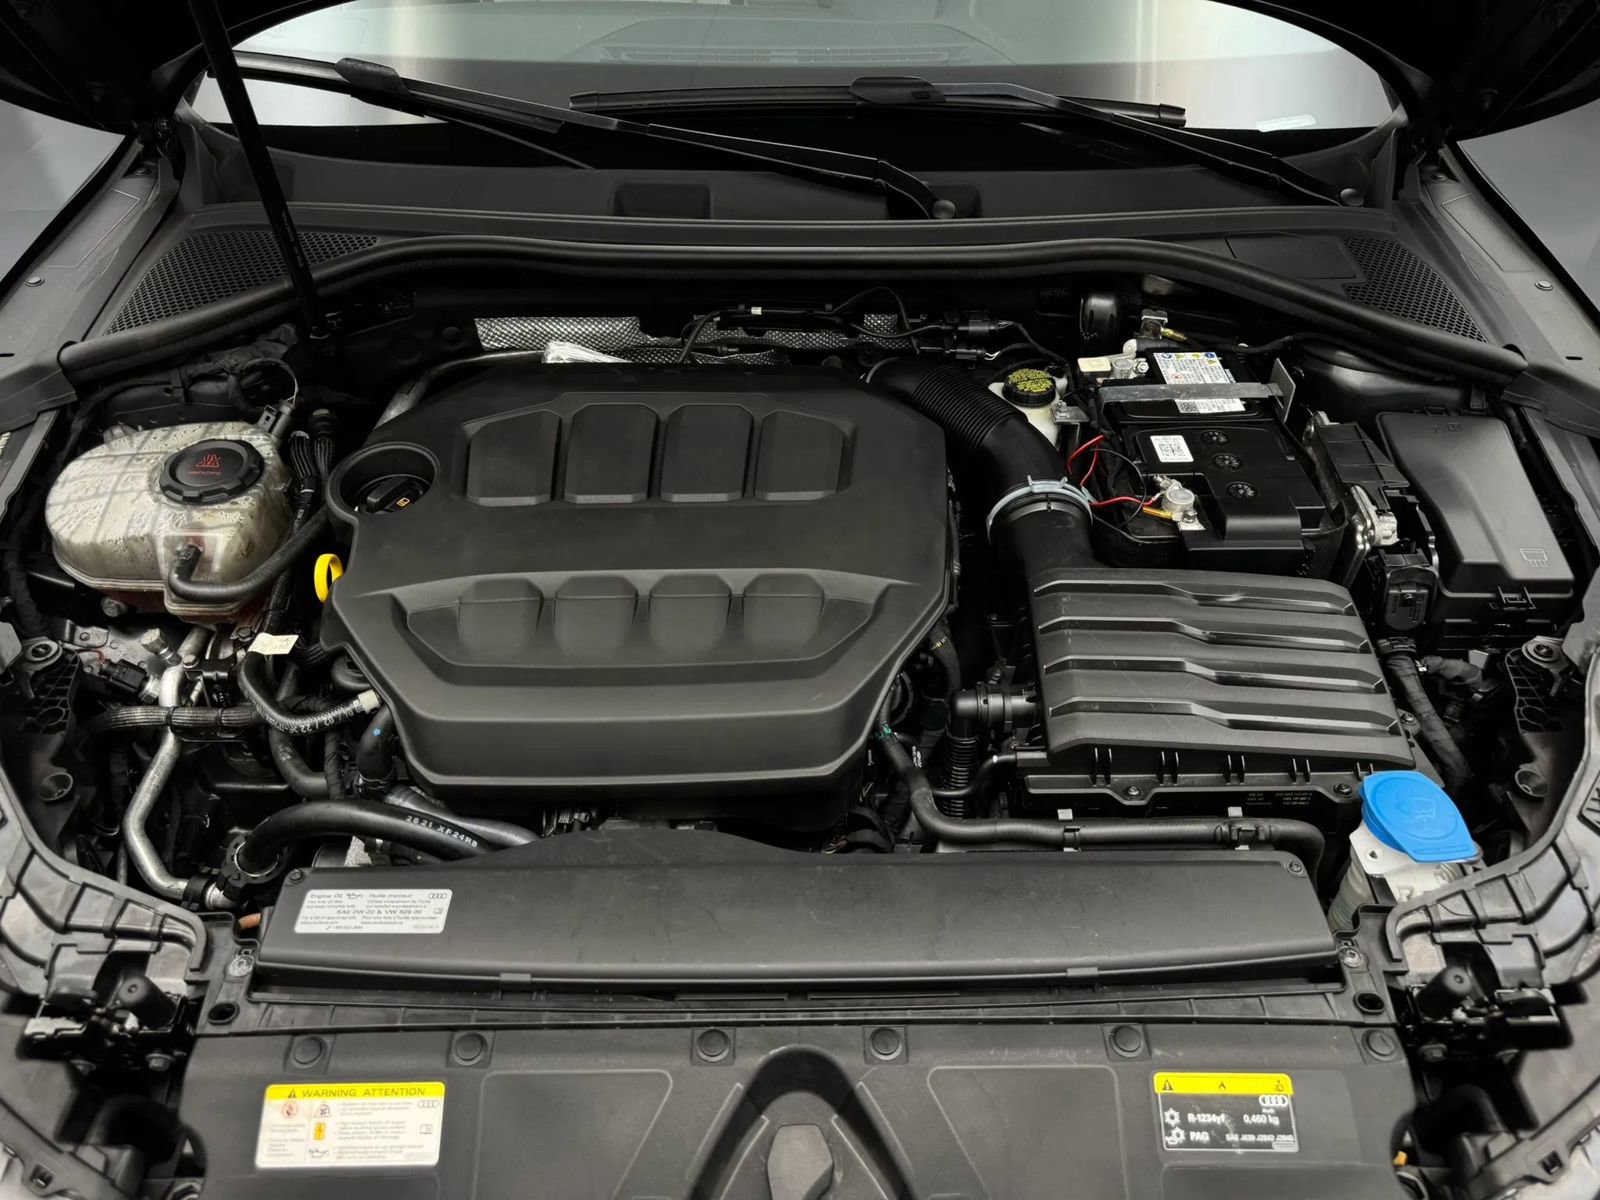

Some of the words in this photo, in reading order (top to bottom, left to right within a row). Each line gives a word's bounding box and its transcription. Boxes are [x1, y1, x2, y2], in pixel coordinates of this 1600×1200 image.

[302, 1088, 357, 1097] WARNING
[362, 1087, 426, 1097] ATTENTION
[1187, 1113, 1225, 1124] R-1234yf
[1268, 1113, 1280, 1126] kg
[1189, 1131, 1210, 1141] PAG
